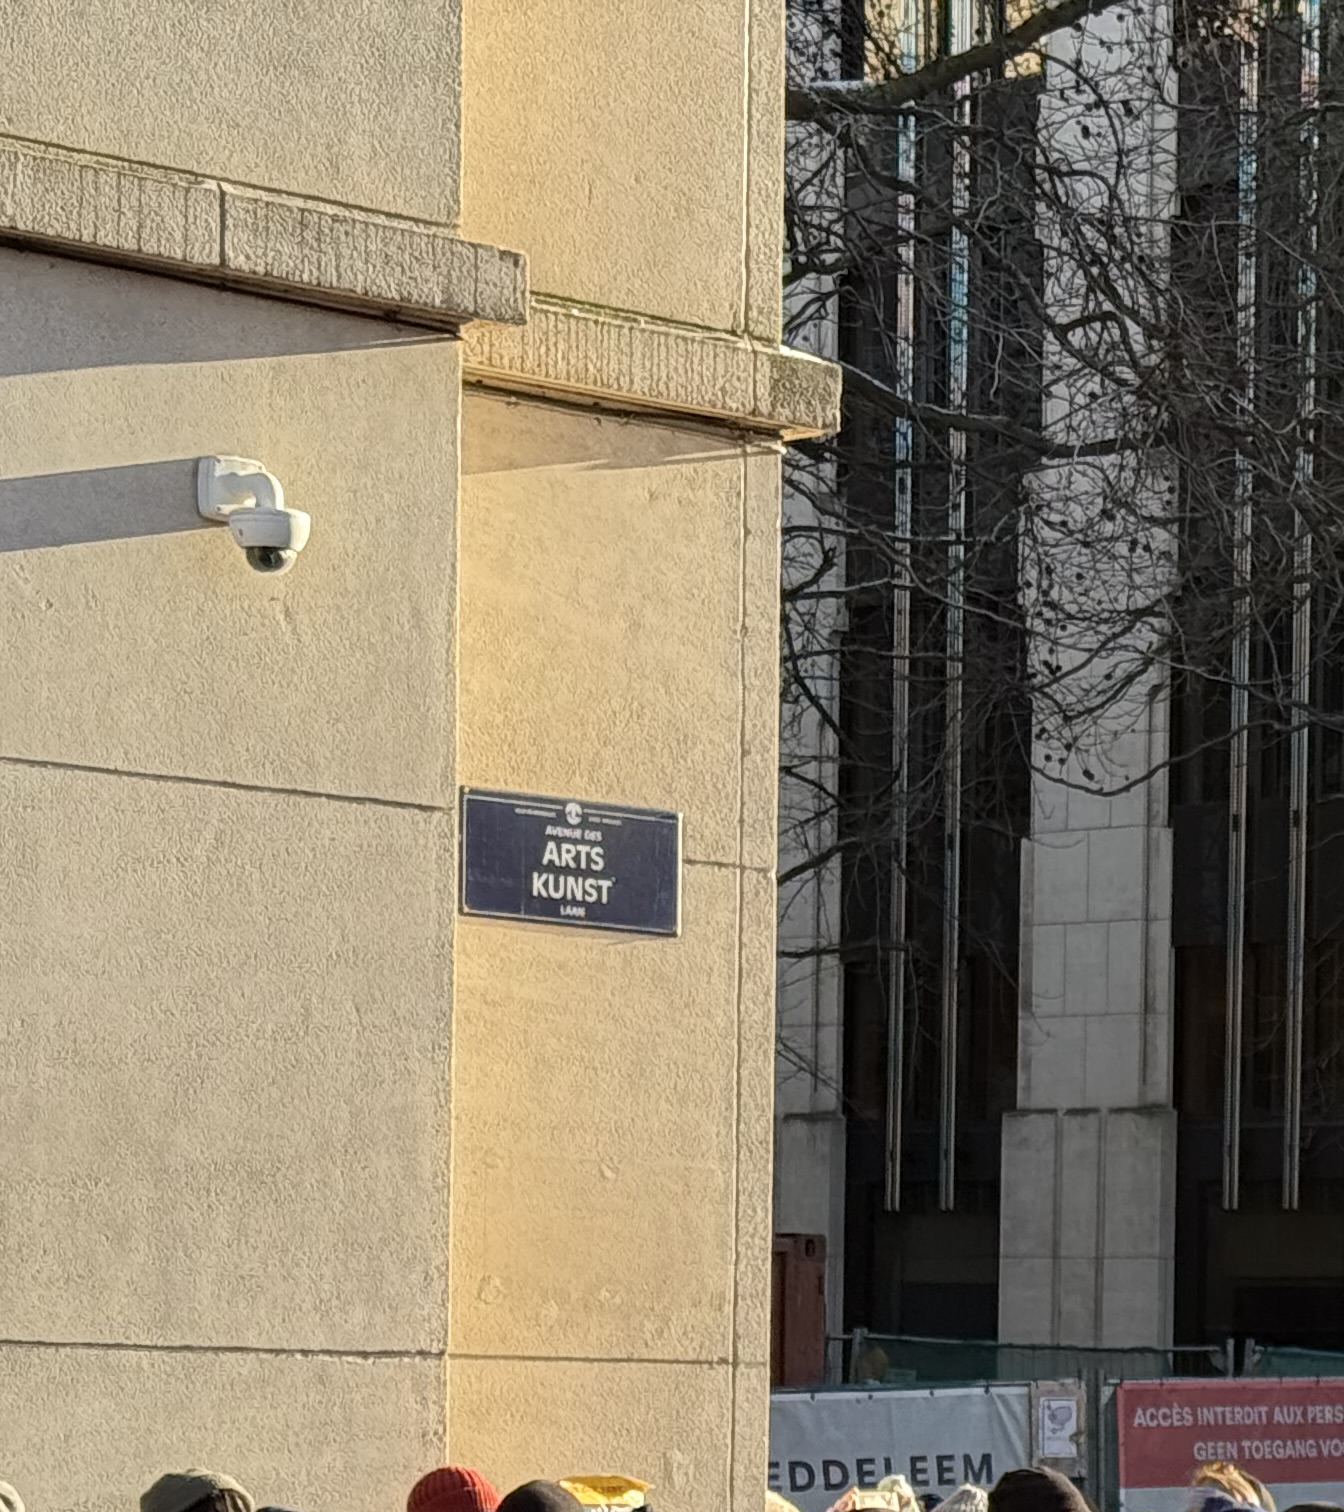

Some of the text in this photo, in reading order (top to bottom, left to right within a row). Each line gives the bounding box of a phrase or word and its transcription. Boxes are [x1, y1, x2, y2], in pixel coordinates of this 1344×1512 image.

[545, 825, 583, 839] AVENUE
[542, 841, 605, 871] ARTS
[532, 872, 613, 905] KUNST
[1133, 1402, 1193, 1428] ACCÈS
[1197, 1405, 1268, 1426] INTERDIT
[1273, 1406, 1304, 1424] AUX
[1193, 1438, 1238, 1461] GEEN
[1241, 1436, 1318, 1460] TOEGANG
